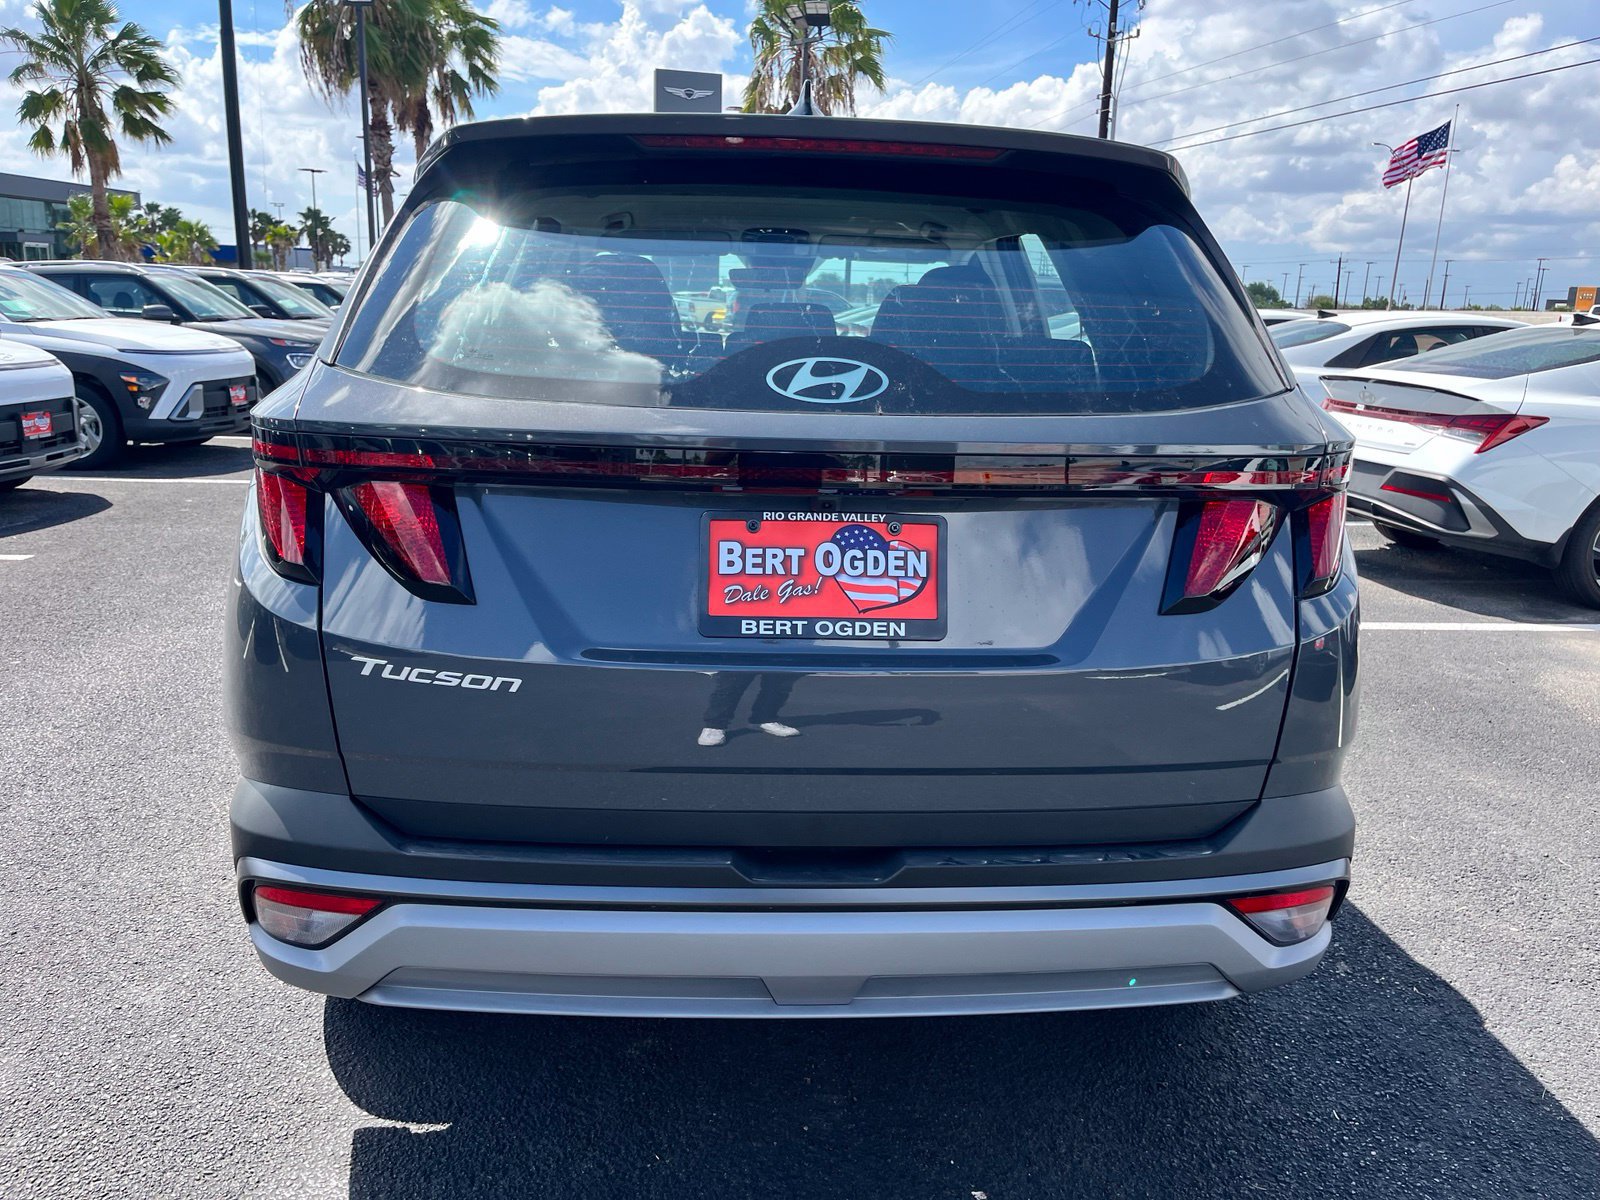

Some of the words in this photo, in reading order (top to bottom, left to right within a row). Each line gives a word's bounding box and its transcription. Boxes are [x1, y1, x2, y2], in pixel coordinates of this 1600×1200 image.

[763, 512, 784, 521] RIO
[788, 512, 839, 522] GRANDE
[841, 513, 886, 523] VALLEY
[718, 541, 805, 575] BERT
[814, 541, 927, 577] OGDEN
[724, 584, 769, 604] Dale
[777, 577, 823, 604] Gas!
[741, 619, 808, 635] BERT
[814, 620, 906, 637] OGDEN
